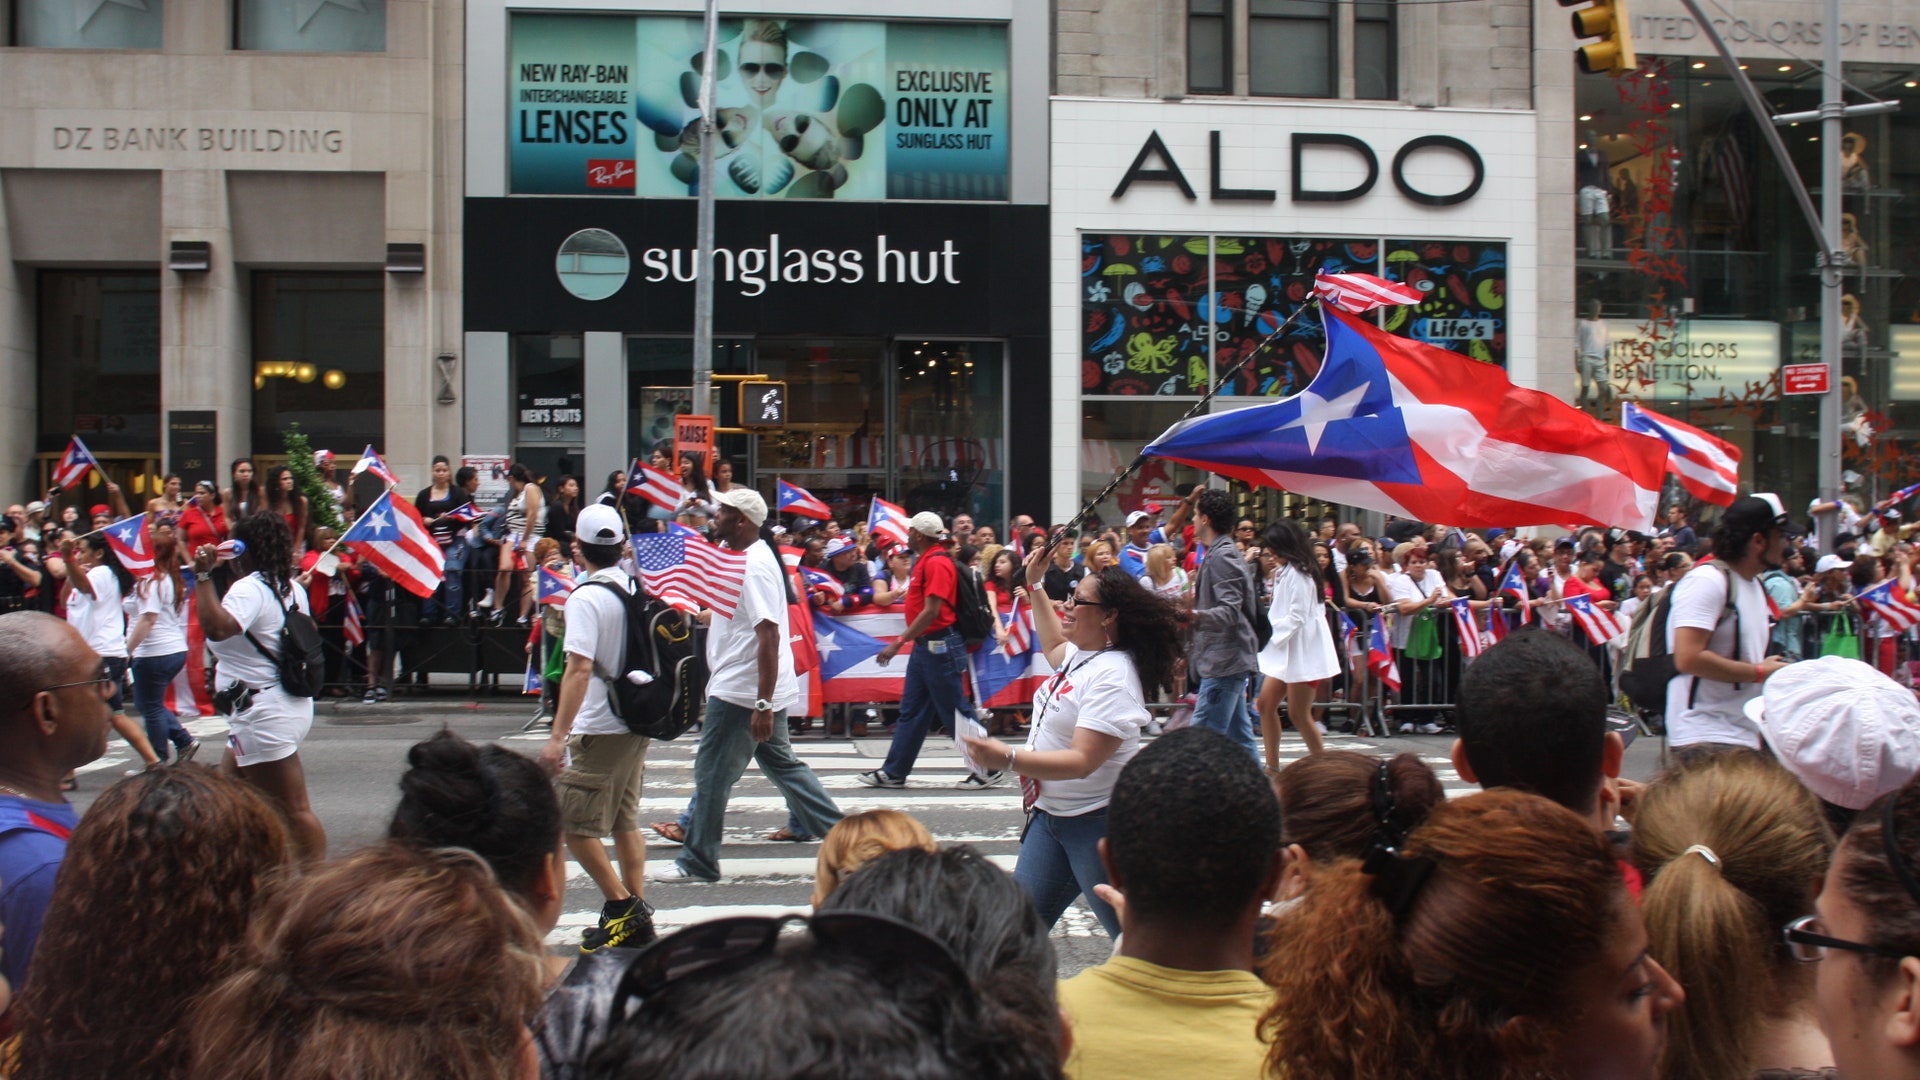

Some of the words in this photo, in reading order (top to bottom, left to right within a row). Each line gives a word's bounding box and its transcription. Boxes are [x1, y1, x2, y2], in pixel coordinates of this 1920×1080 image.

[1631, 17, 1697, 41] ITED
[521, 64, 557, 82] NEW
[561, 65, 628, 83] RAY-BAN
[897, 70, 993, 94] EXCLUSIVE
[520, 89, 628, 105] INTERCHANGEABLE
[897, 97, 959, 128] ONLY
[964, 99, 993, 128] AT
[521, 110, 628, 145] LENSES
[53, 127, 93, 150] DZ
[103, 127, 188, 151] BANK
[198, 128, 344, 153] BUILDING
[897, 132, 964, 150] SUNGLASS
[967, 134, 993, 151] HUT
[1111, 129, 1486, 207] ALDO
[643, 233, 865, 297] sunglass
[877, 234, 961, 285] hut
[1430, 320, 1485, 338] Life's
[1612, 340, 1656, 358] ITED
[1660, 342, 1739, 359] COLORS
[521, 408, 551, 423] MEN'S
[552, 408, 582, 423] SUITS
[679, 425, 708, 443] RAISE
